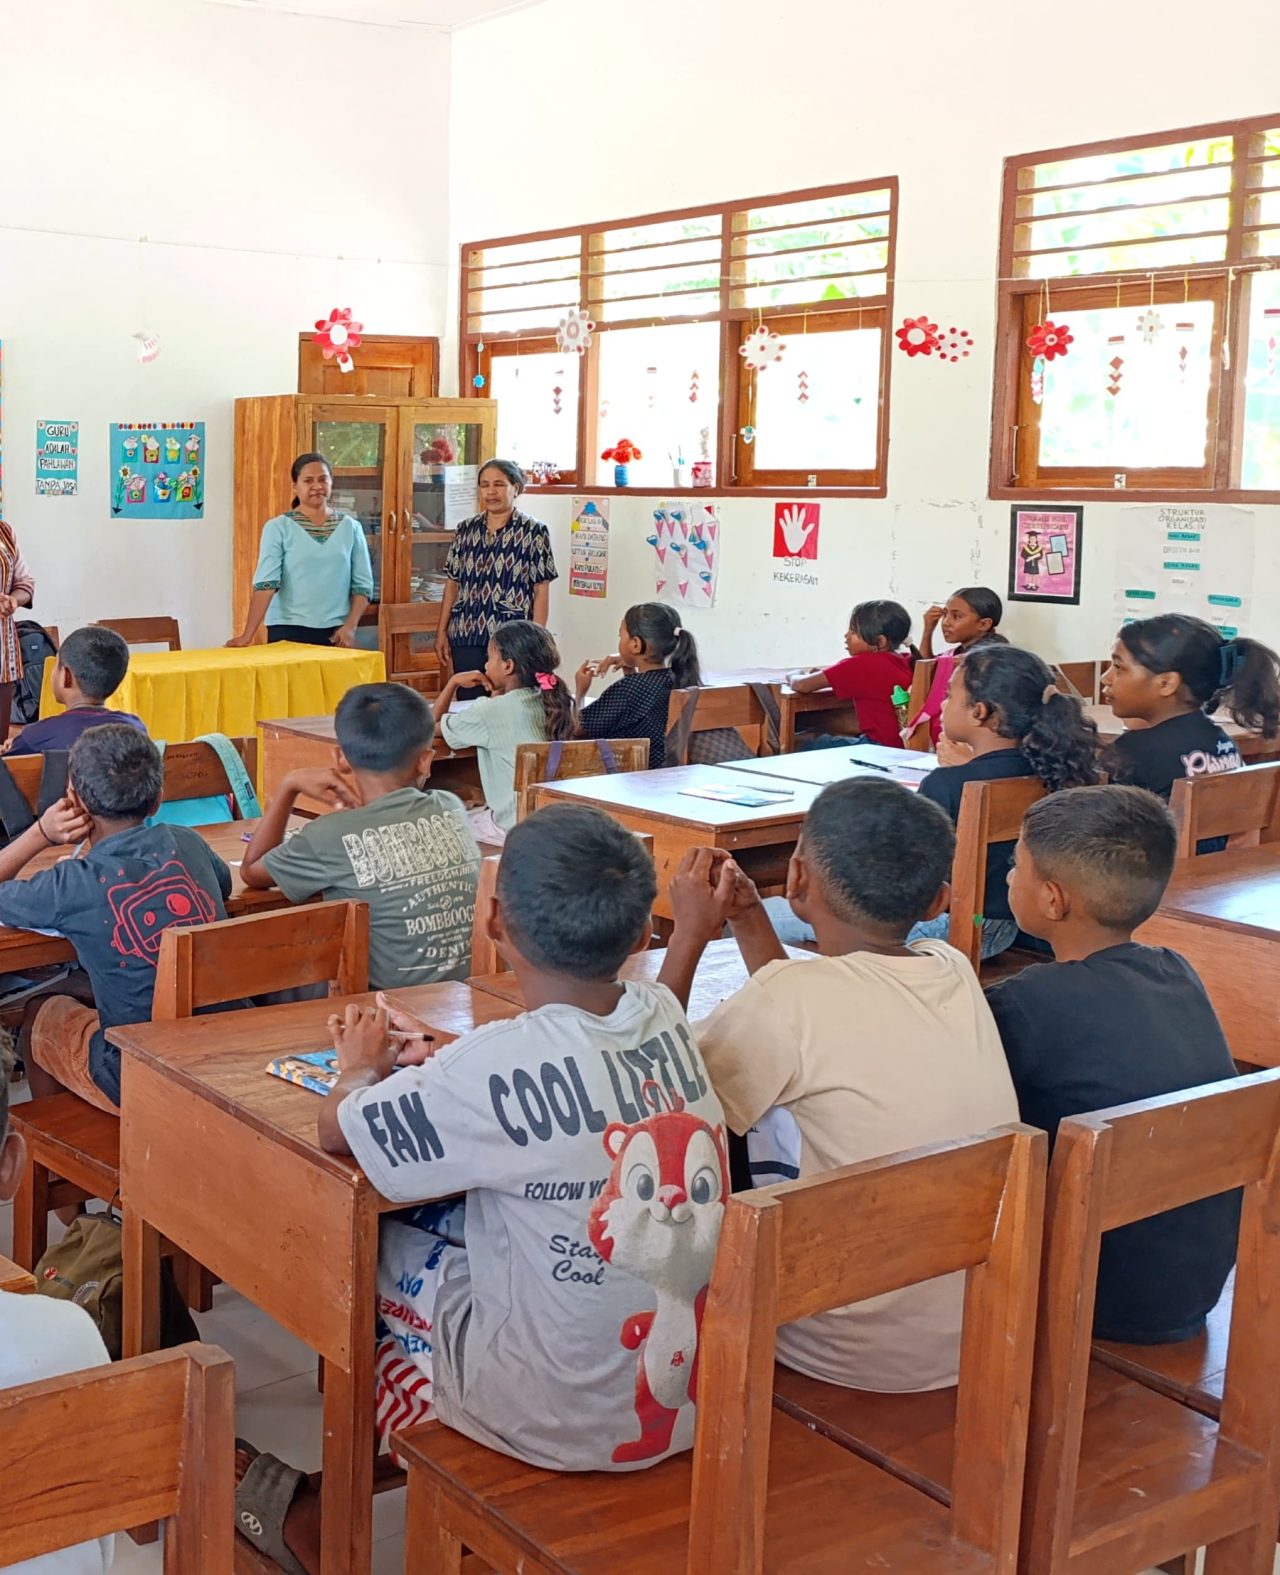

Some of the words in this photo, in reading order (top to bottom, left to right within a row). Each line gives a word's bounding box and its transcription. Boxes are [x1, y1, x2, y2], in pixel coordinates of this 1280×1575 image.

[46, 425, 69, 437] GURU
[45, 442, 70, 455] ADALAH
[39, 458, 74, 471] PAHLAWAN
[35, 480, 60, 491] TANPA
[1166, 522, 1194, 530] KELAS
[783, 557, 807, 568] STOP
[407, 879, 475, 911] AUTHENTIC
[488, 1055, 607, 1147] COOL
[524, 1181, 587, 1201] FOLLOW
[551, 1259, 606, 1286] Cool
